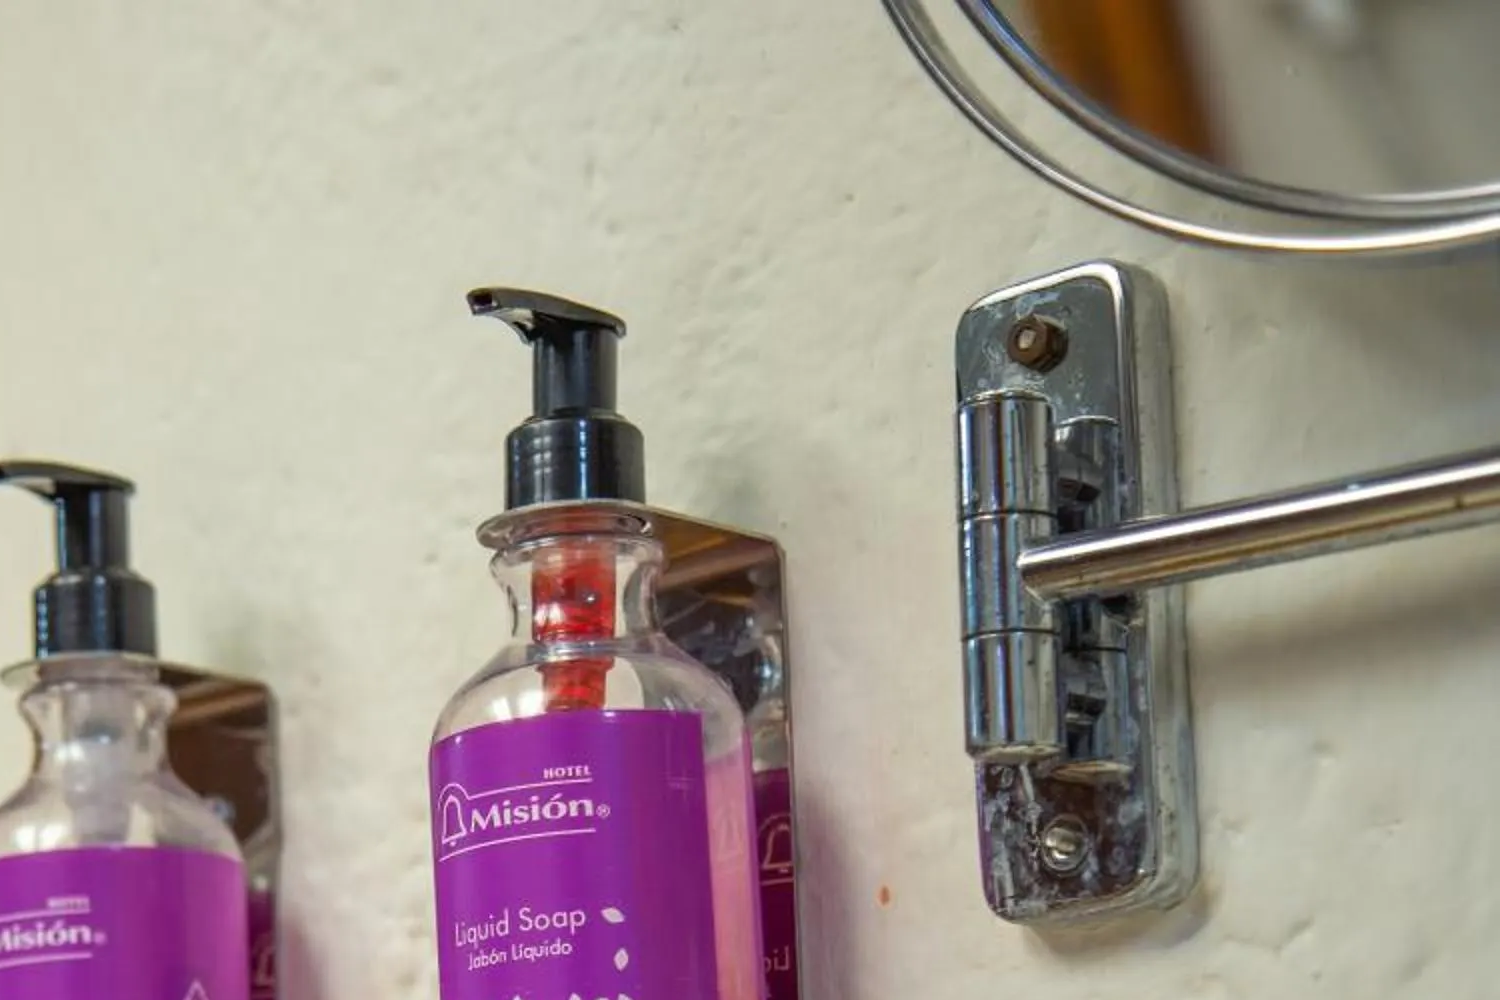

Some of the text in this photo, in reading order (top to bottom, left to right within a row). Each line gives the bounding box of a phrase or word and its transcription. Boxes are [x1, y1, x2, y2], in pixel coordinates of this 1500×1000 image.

[543, 765, 591, 779] HOTEL
[454, 906, 587, 949] Liquid Soap
[467, 937, 573, 971] Jabón Líquido
